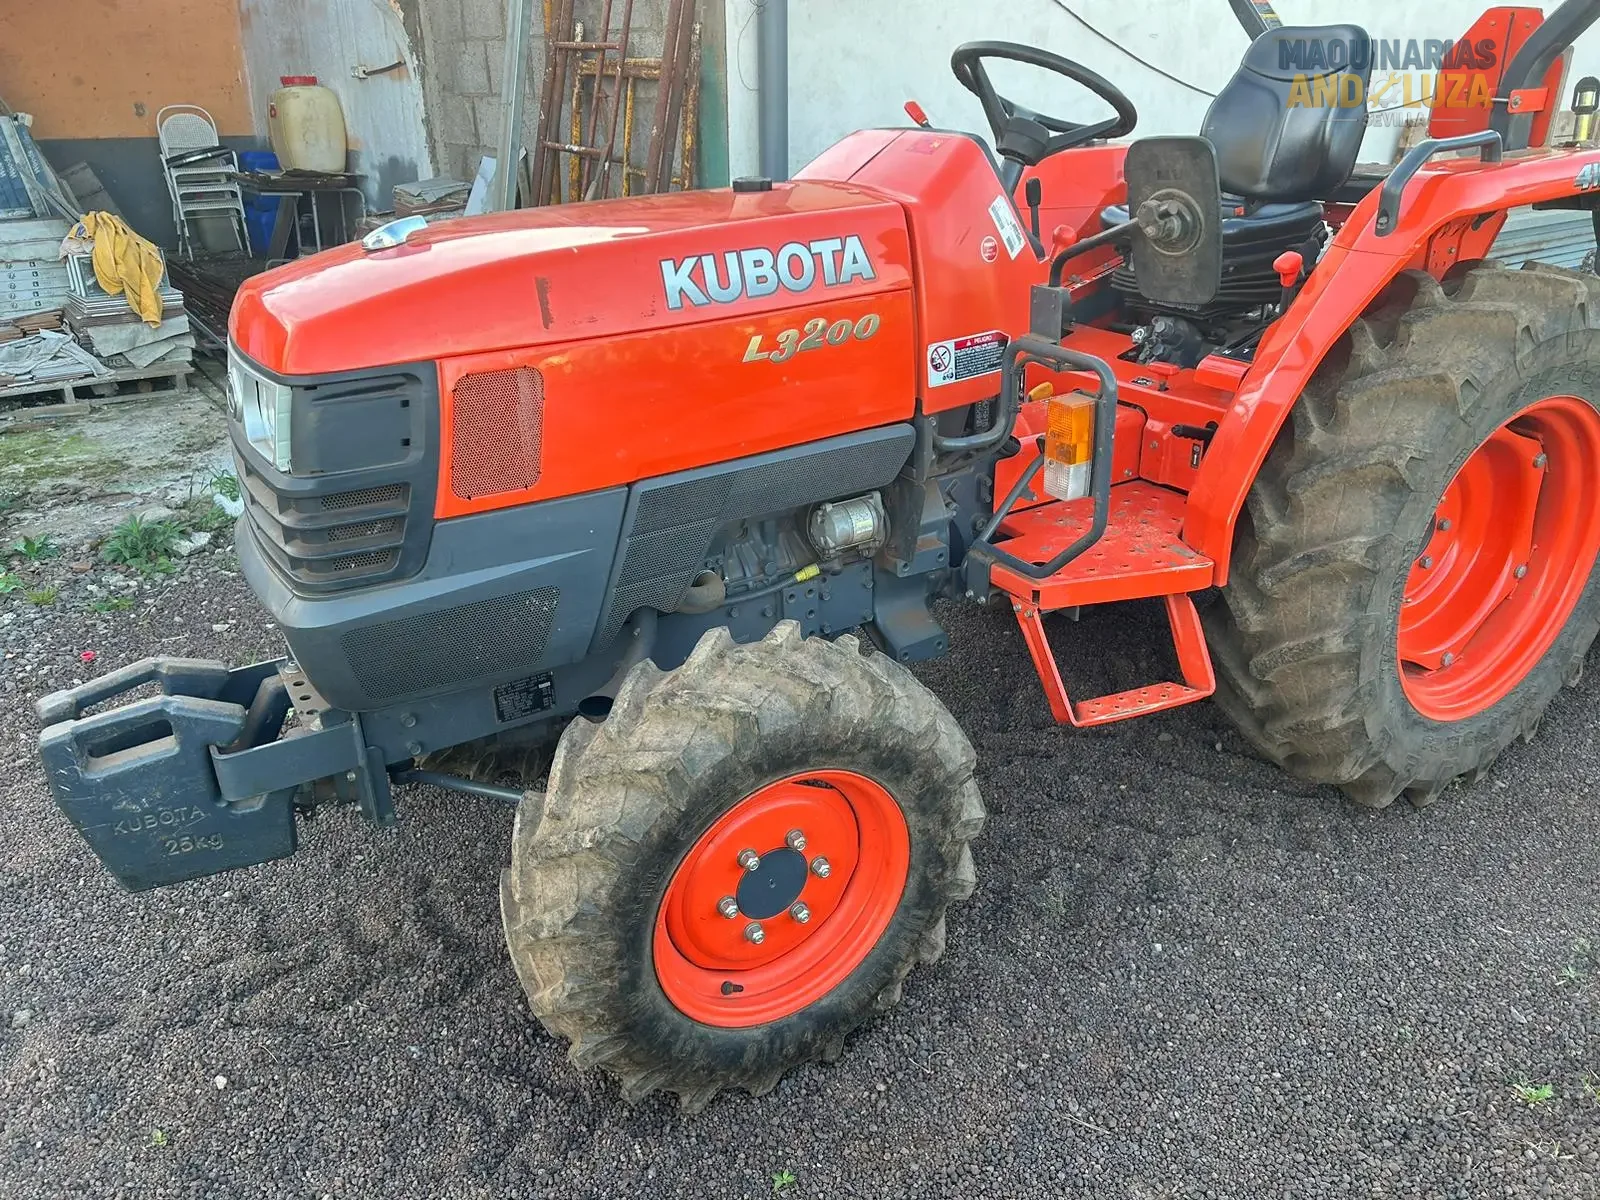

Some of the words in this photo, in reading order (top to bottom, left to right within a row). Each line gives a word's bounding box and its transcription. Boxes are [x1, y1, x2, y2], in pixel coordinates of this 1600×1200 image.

[660, 234, 877, 310] KUBOTA
[742, 313, 881, 364] L3200
[974, 335, 992, 344] PELIGRO
[113, 806, 206, 835] KUBOTA
[164, 832, 224, 856] 25kg
